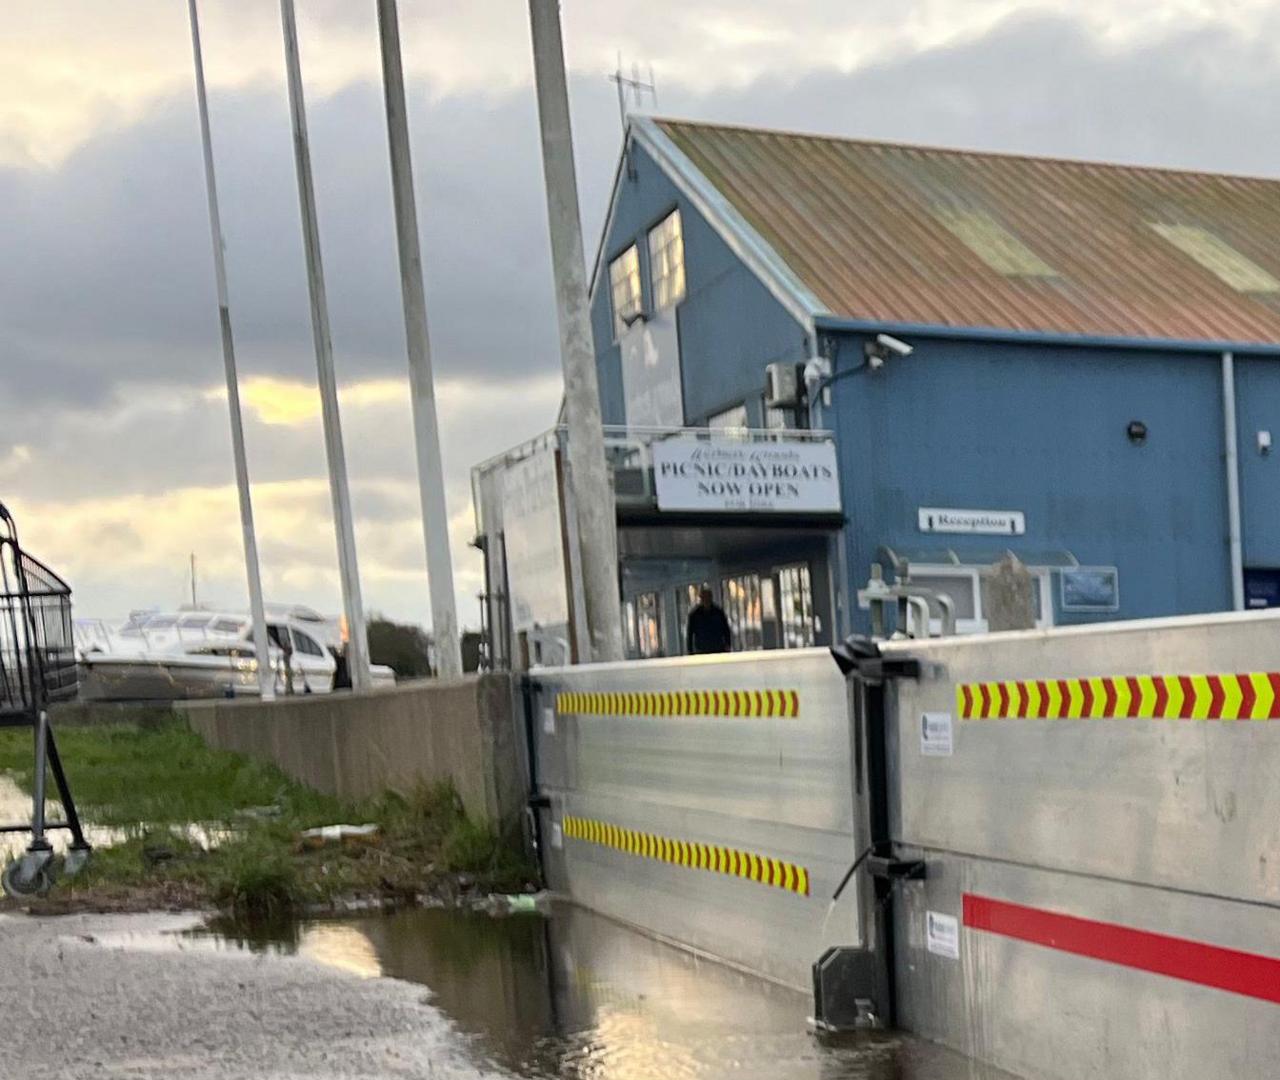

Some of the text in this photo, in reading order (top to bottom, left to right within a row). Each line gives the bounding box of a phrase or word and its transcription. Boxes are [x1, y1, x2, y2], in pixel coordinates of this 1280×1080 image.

[698, 482, 799, 497] NOW OPEN
[938, 514, 1007, 528] Reception
